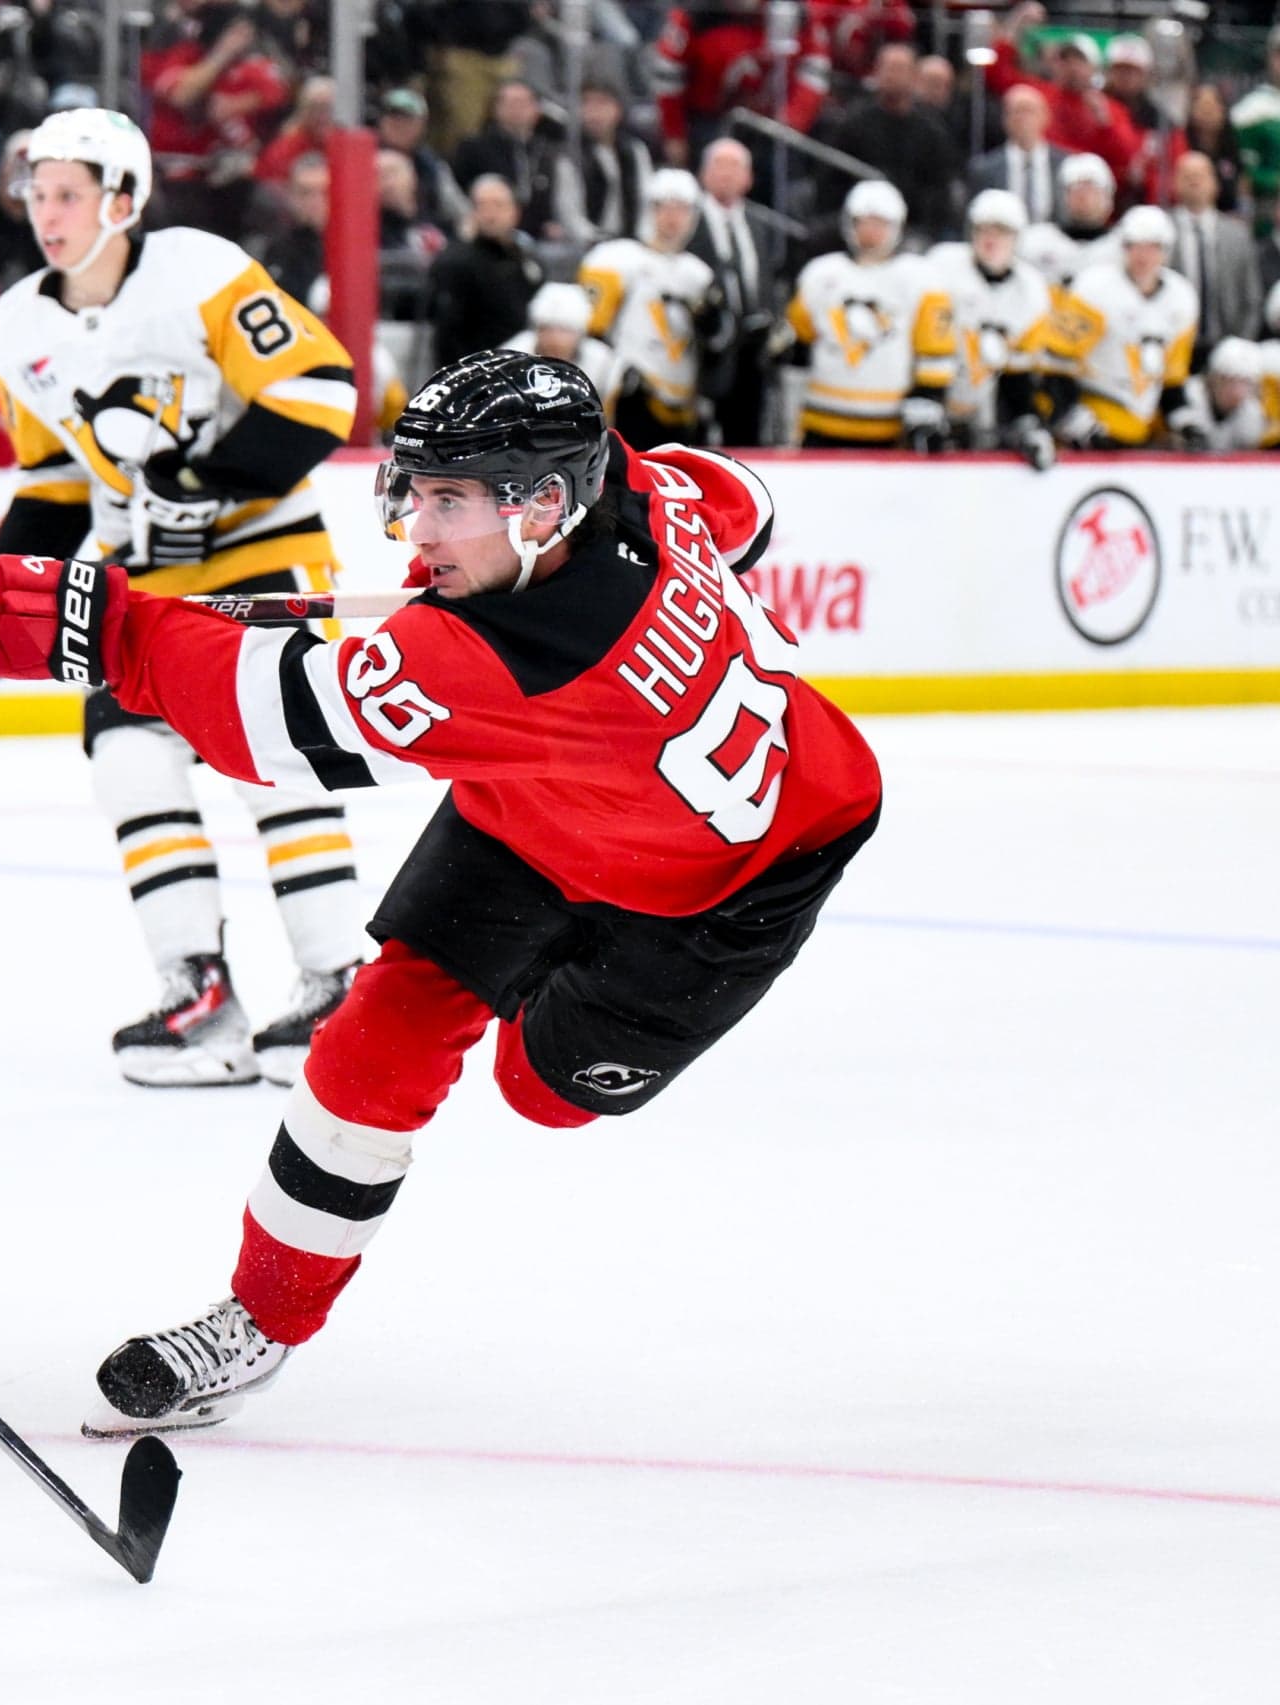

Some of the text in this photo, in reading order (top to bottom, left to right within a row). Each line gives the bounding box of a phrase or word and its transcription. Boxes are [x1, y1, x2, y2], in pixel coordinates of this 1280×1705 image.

[535, 395, 572, 411] Prudential
[617, 500, 723, 717] HUGHES
[347, 632, 451, 747] 86
